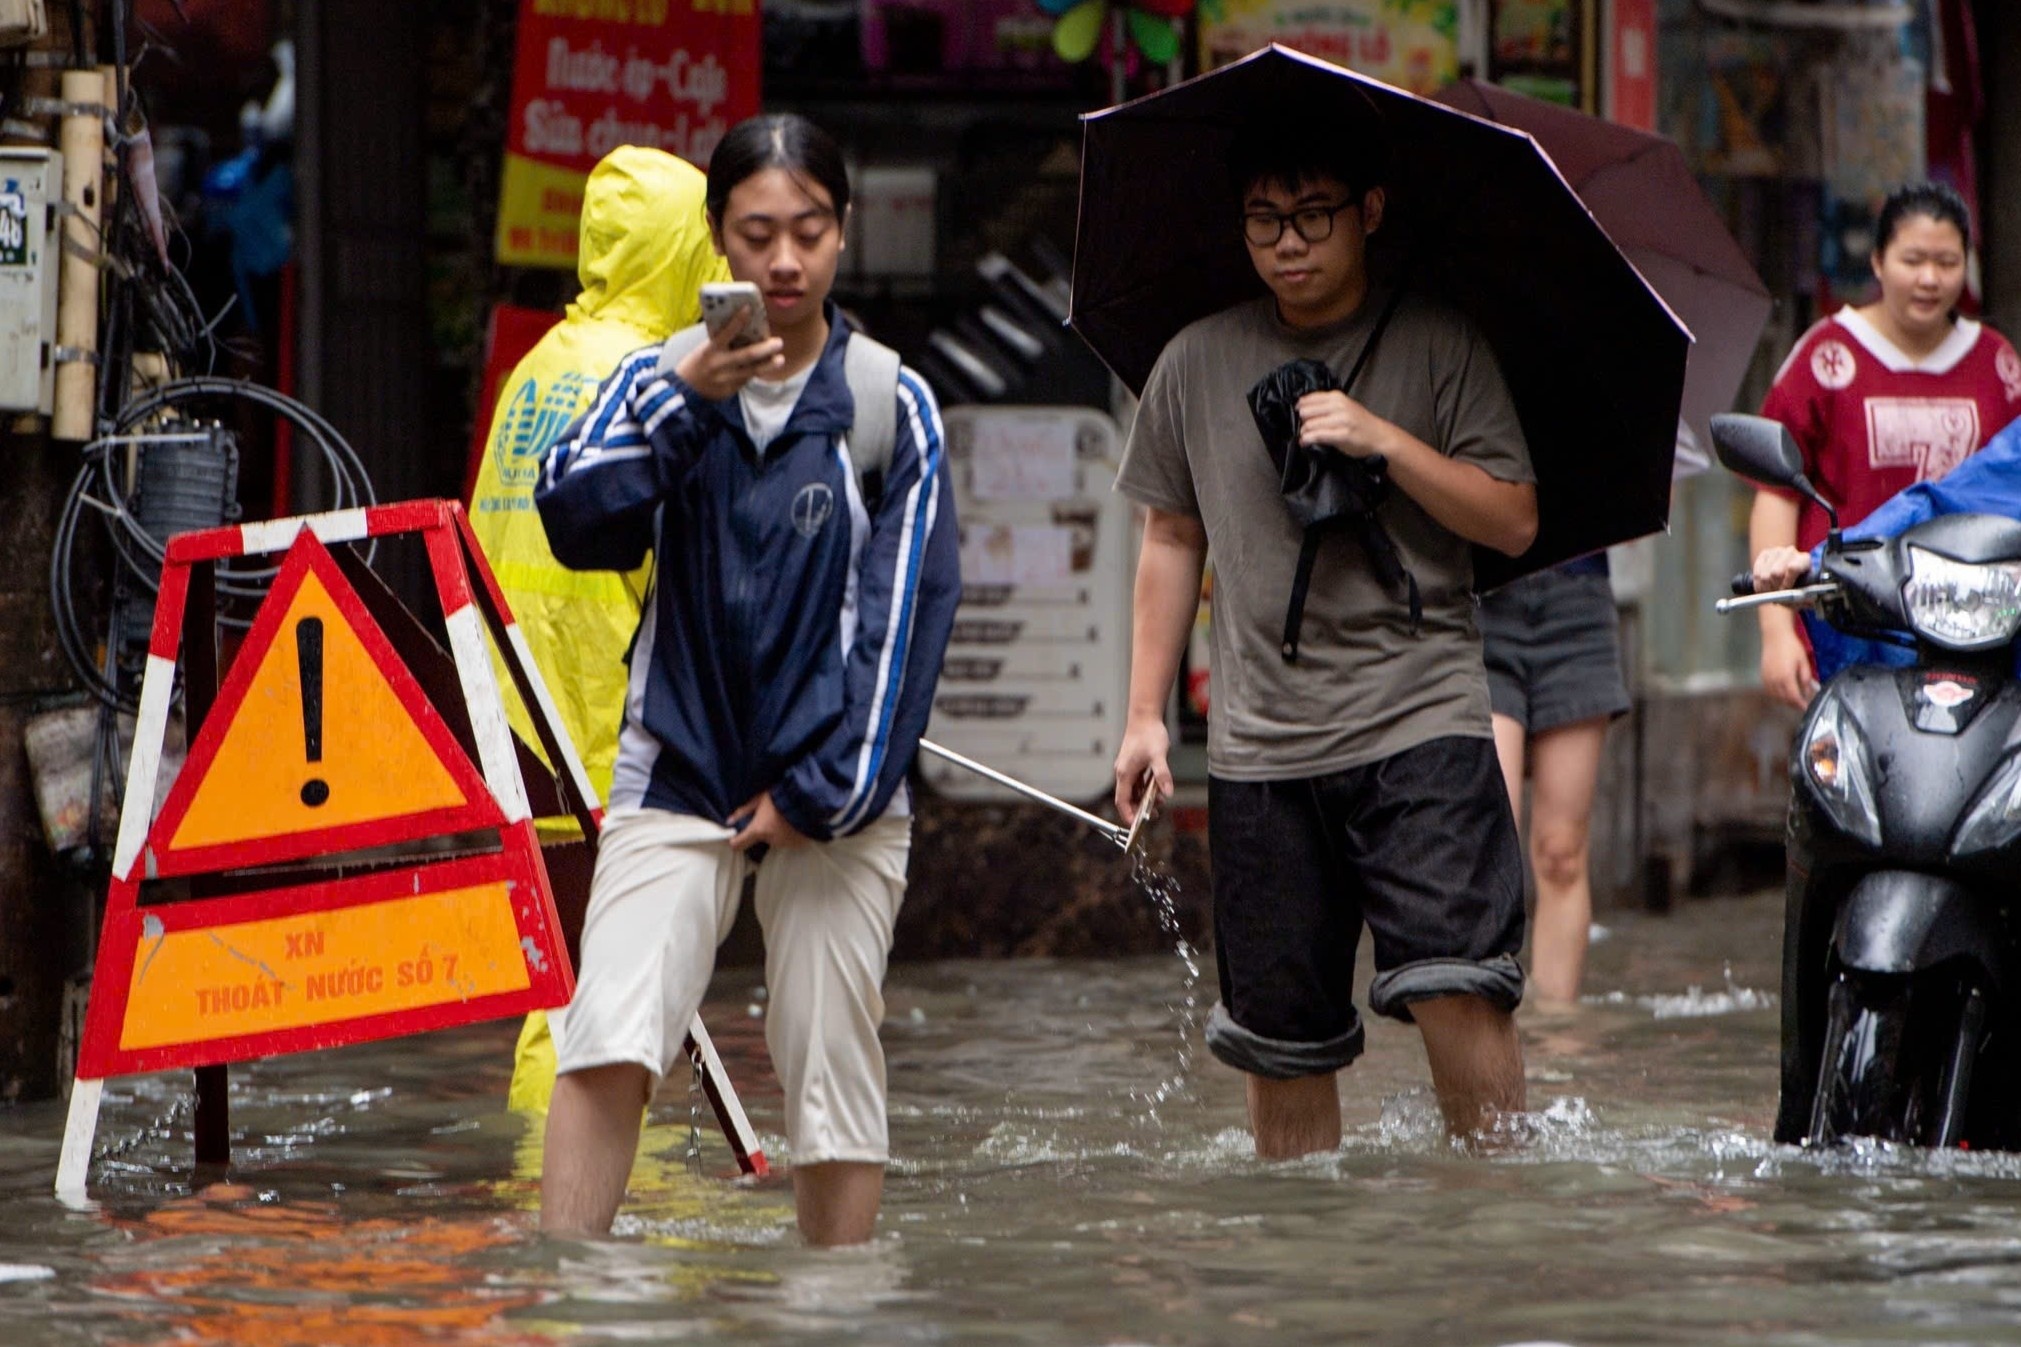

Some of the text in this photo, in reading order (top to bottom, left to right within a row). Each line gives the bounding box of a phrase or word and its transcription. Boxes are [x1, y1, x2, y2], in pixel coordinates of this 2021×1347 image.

[1864, 397, 1979, 484] 7
[195, 943, 459, 1016] THOÁT NƯỚC SỐ 7
[285, 931, 324, 960] XN
